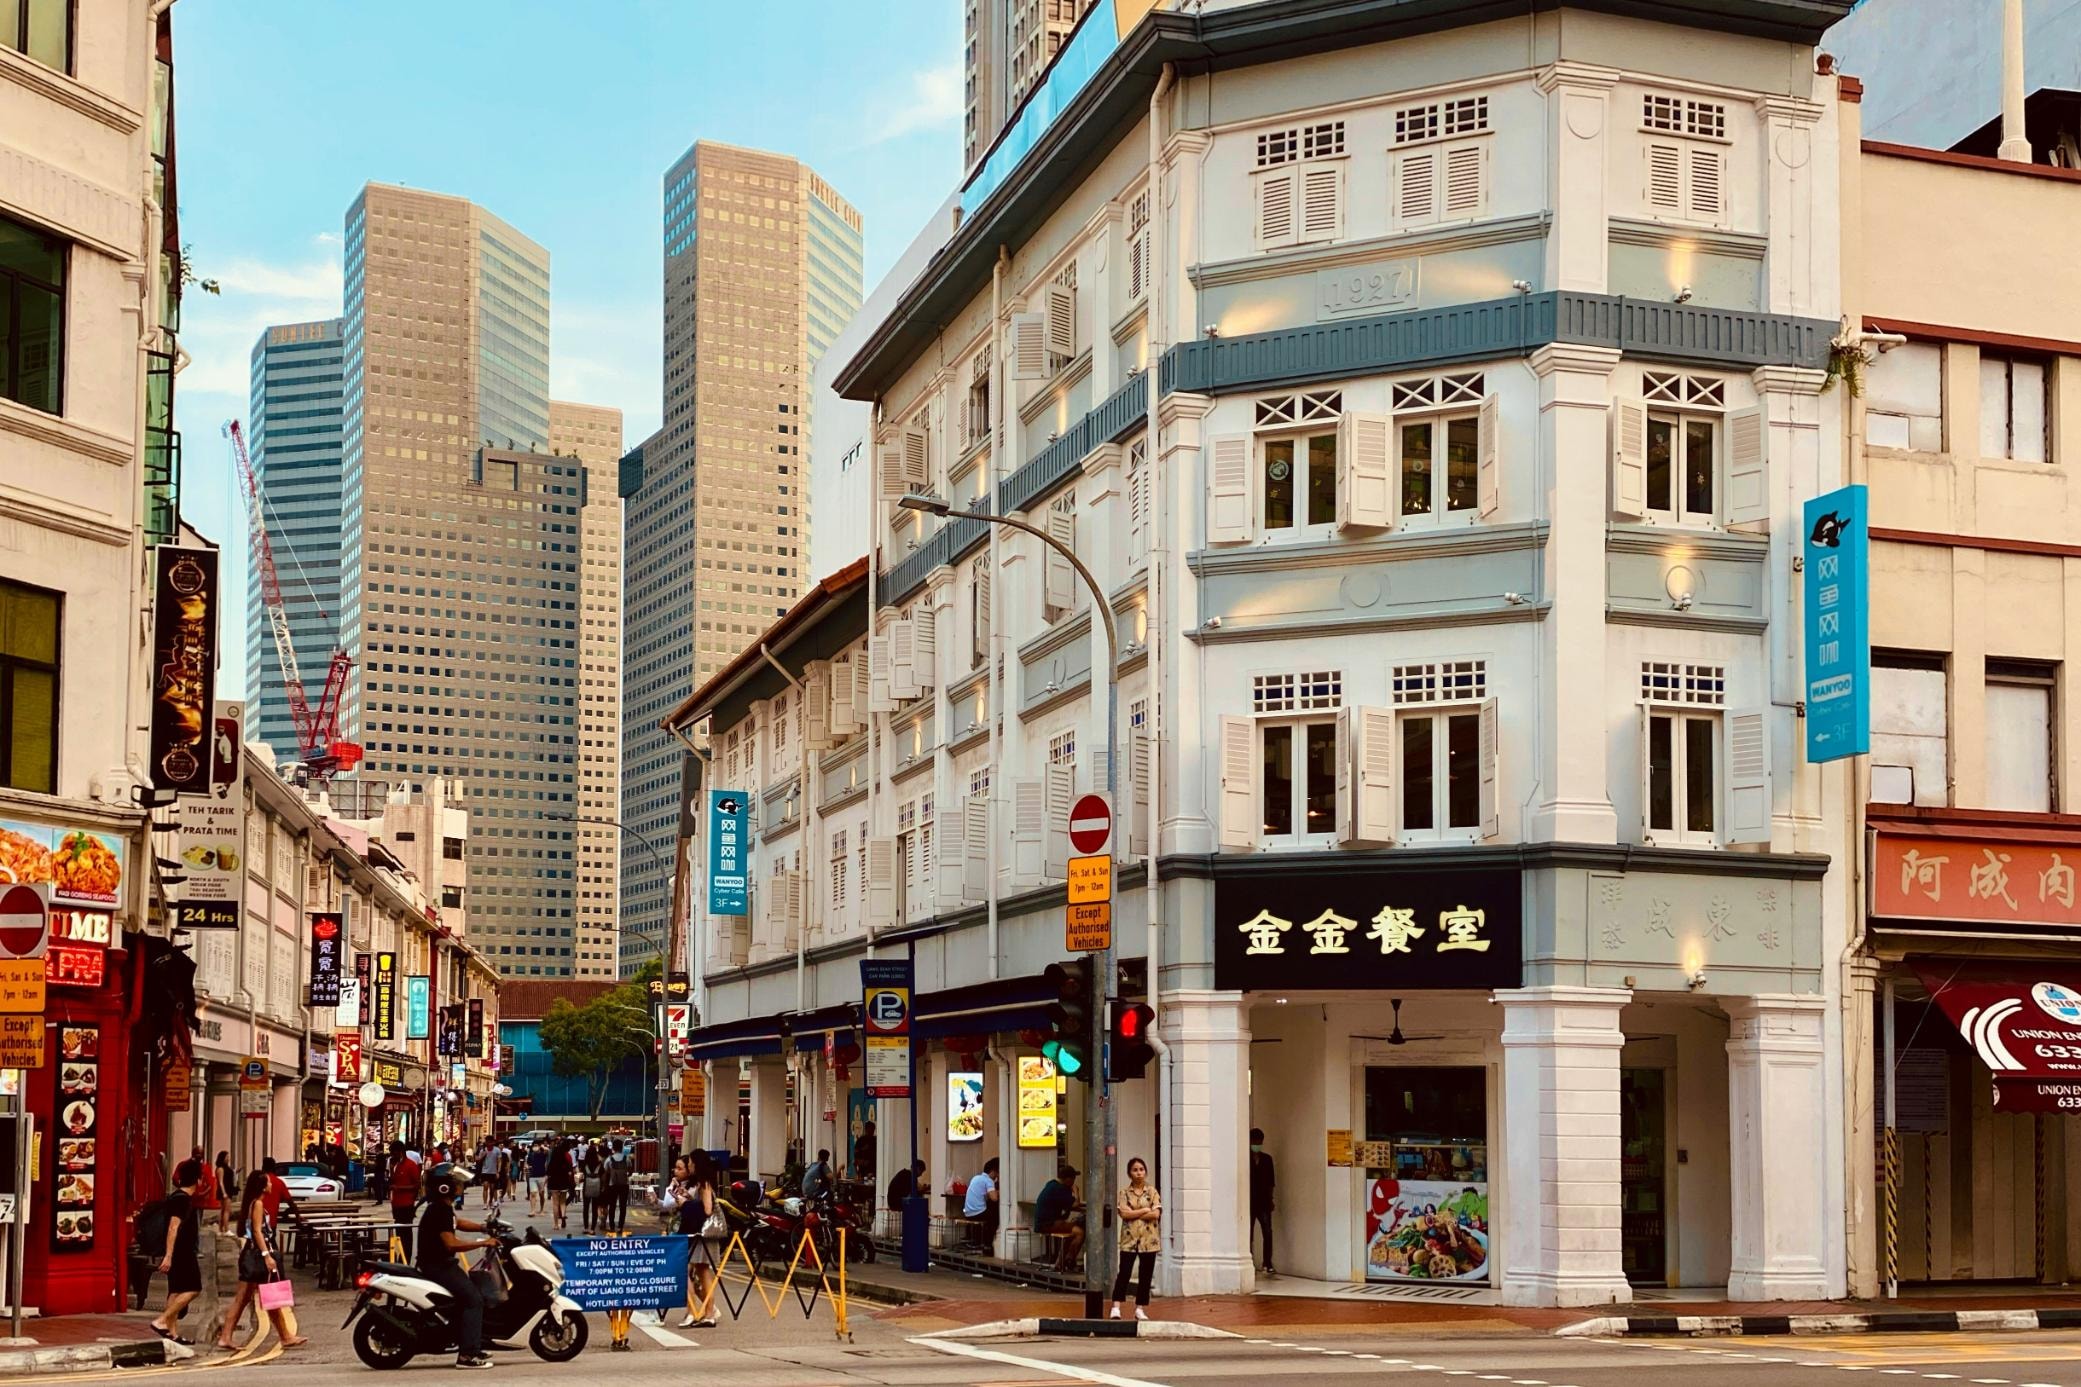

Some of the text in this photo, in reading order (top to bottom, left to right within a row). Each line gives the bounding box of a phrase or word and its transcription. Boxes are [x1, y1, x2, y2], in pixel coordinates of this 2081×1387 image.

[1331, 271, 1403, 306] 1927
[1812, 679, 1851, 698] WANYOO
[1833, 723, 1851, 741] 3F
[188, 806, 235, 815] TEH TARIK
[207, 817, 214, 825] &
[183, 826, 238, 836] PRATA TIME
[1092, 868, 1097, 876] &
[1099, 866, 1108, 875] Sun
[1075, 883, 1085, 894] 7pm
[1091, 882, 1104, 891] 12am
[715, 899, 728, 907] 3F
[183, 908, 234, 923] 24 Hrs
[1075, 905, 1101, 921] Except
[1068, 920, 1109, 934] Authorised
[1238, 904, 1491, 955] 金金餐室
[1073, 936, 1104, 948] Vehicles
[0, 971, 44, 983] ri, Sat & Sun
[3, 990, 15, 999] 7pm
[22, 990, 38, 999] 12am
[877, 993, 902, 1019] P
[4, 1017, 34, 1032] Except
[2011, 1029, 2062, 1040] UNION
[0, 1036, 43, 1050] uthorised
[1, 1053, 36, 1067] Vehicles
[338, 1041, 358, 1076] SPA
[2037, 1085, 2071, 1095] UNION
[590, 1239, 650, 1250] NO ENTRY
[566, 1277, 676, 1287] TEMPORARY ROAD CLOSURE
[566, 1285, 678, 1296] PART OF LIANG SEAH STREET
